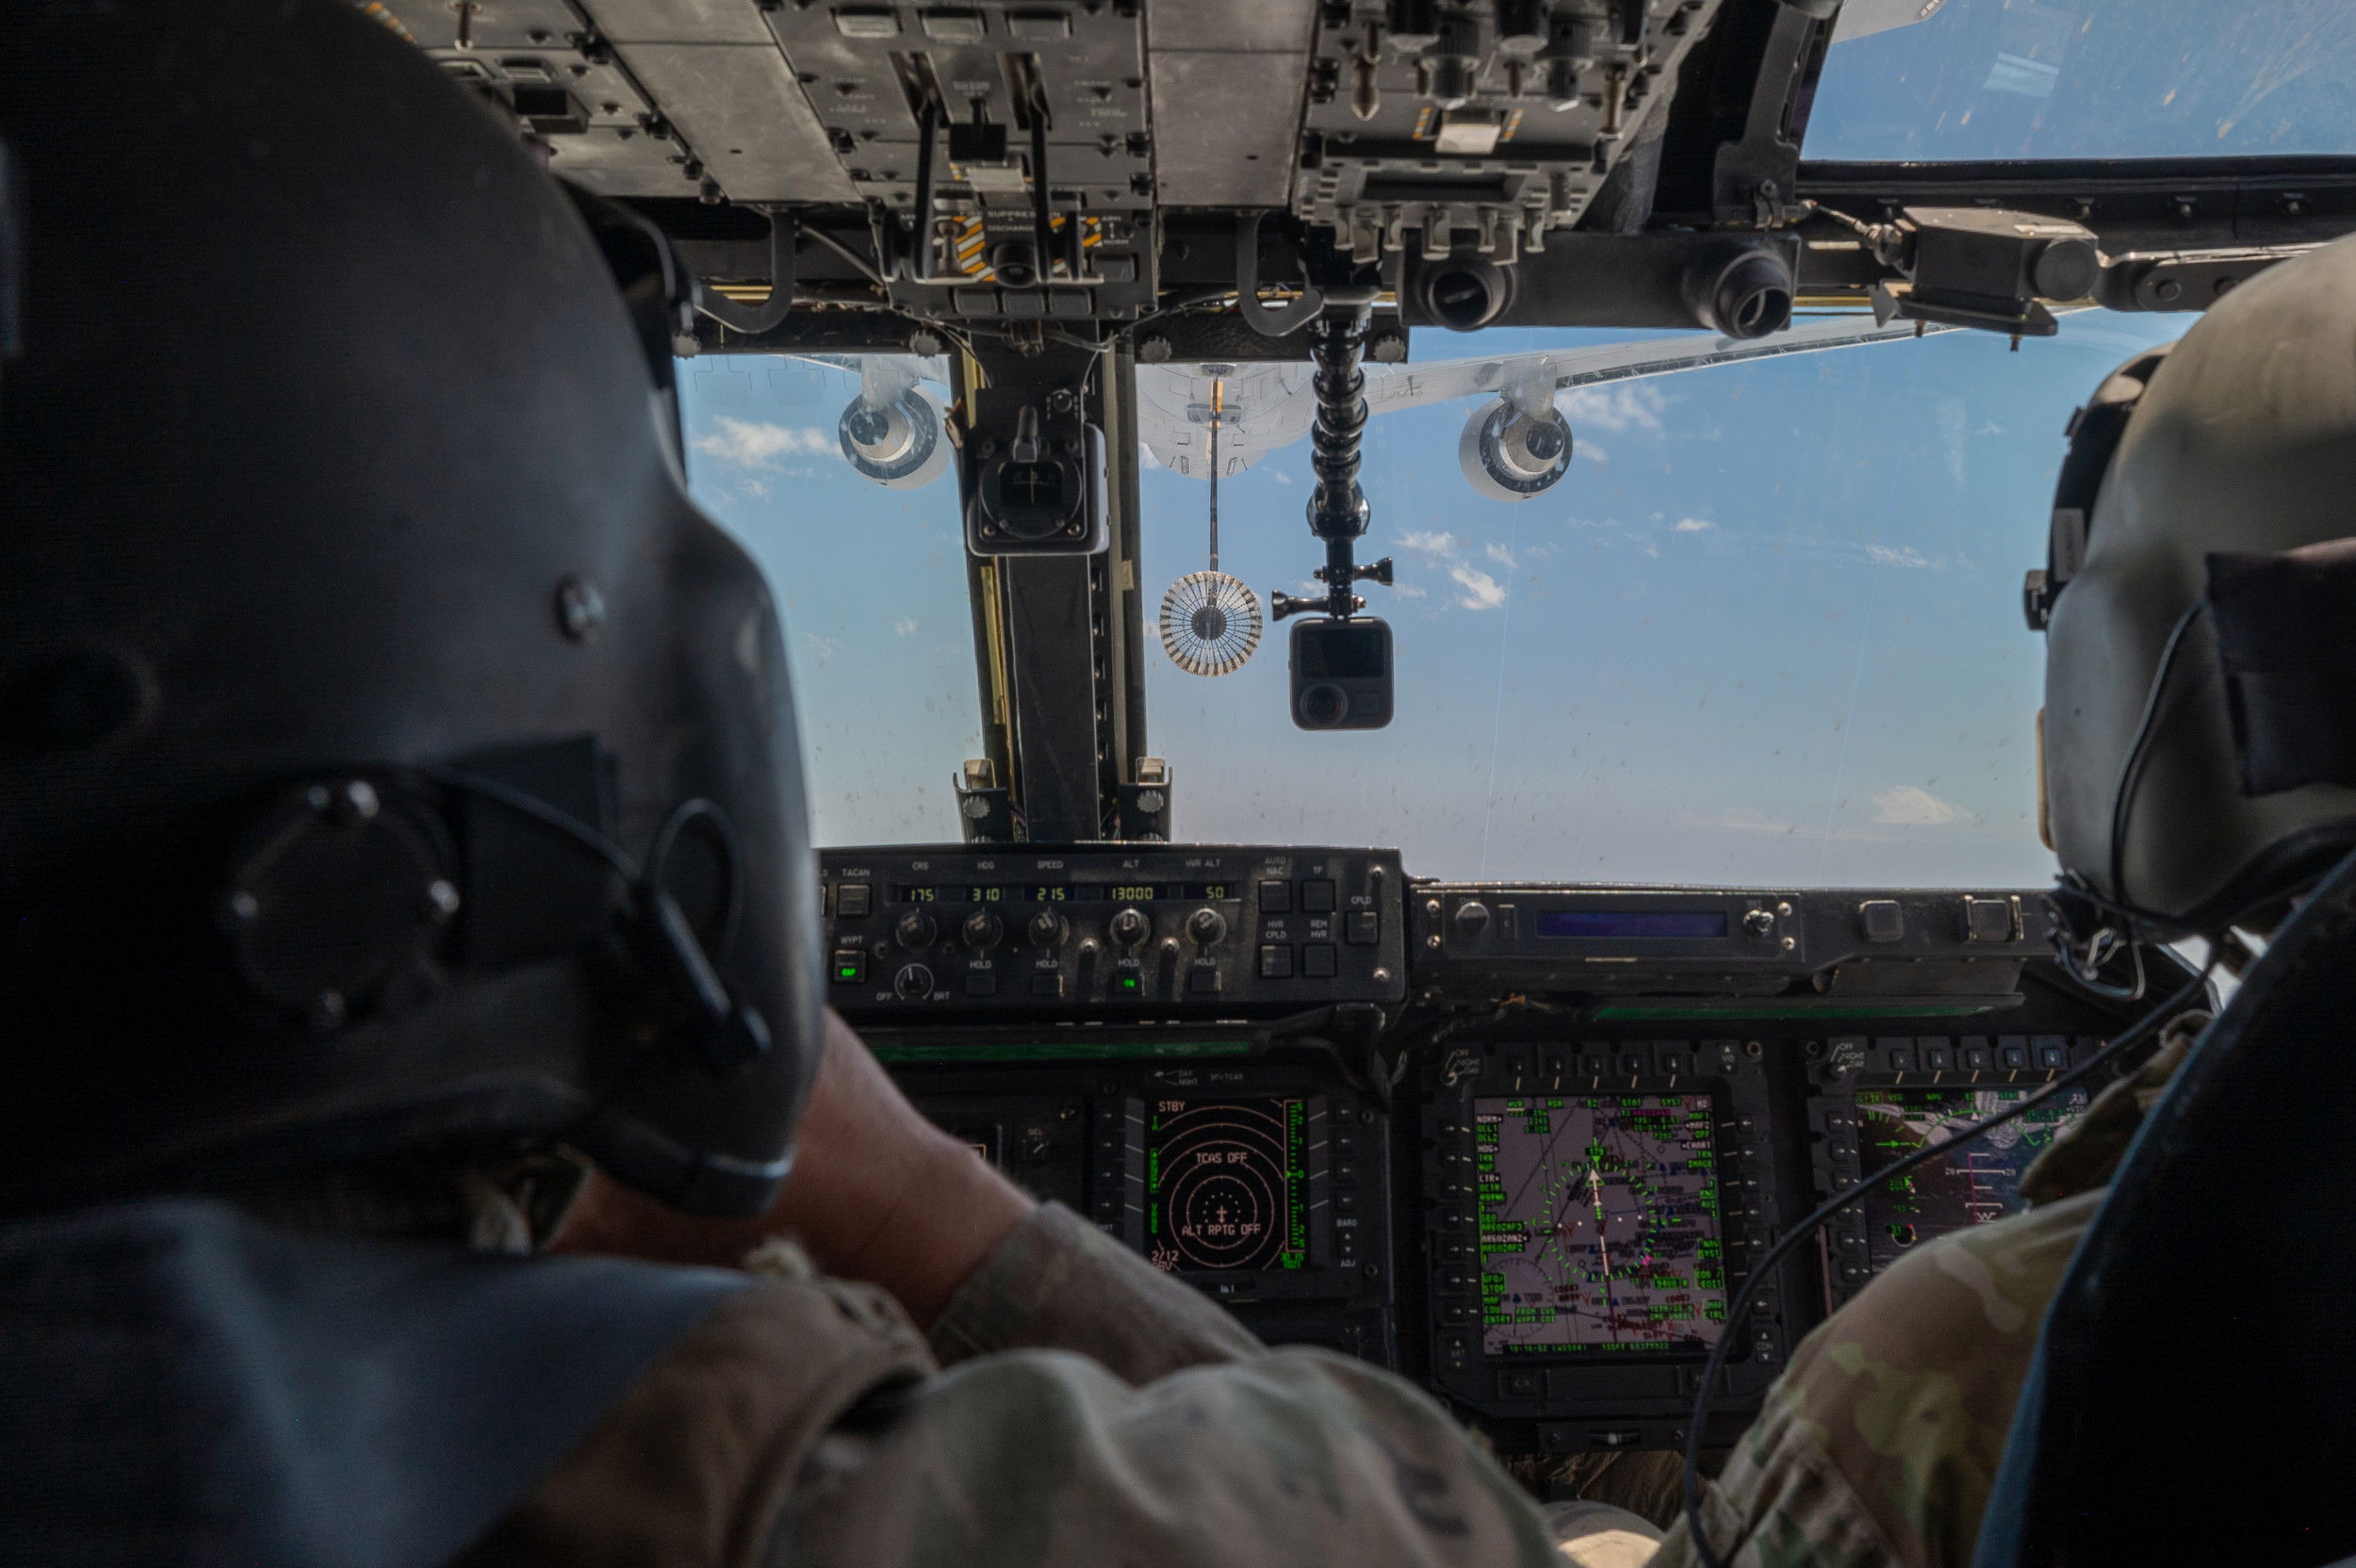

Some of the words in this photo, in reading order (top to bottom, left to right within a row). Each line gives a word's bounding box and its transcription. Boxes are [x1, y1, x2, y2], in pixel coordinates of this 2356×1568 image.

[911, 860, 929, 871] CRS
[977, 860, 995, 871] HDG
[1037, 859, 1064, 870] SPEED
[1122, 859, 1140, 868] ALT
[1204, 858, 1222, 868] ALT
[842, 868, 871, 877] TACAN
[910, 889, 935, 902] 175
[973, 888, 1001, 902] 310
[1036, 887, 1066, 902] 215
[1111, 887, 1154, 901] 13000
[1350, 896, 1372, 906] CPLD
[1265, 931, 1287, 940] CPLD
[969, 959, 992, 970] HOLD
[1035, 959, 1058, 969] HOLD
[1117, 957, 1141, 968] HOLD
[1193, 956, 1217, 967] HOLD
[875, 992, 893, 1002] OFF
[1839, 1042, 1854, 1052] OFF
[1158, 1101, 1186, 1112] STBY
[1196, 1152, 1222, 1164] TCAS
[1227, 1152, 1248, 1164] OFF
[1336, 1218, 1358, 1228] BARO
[1182, 1224, 1203, 1236] ALT
[1207, 1224, 1235, 1235] RPTG
[1240, 1223, 1262, 1234] OFF
[1340, 1259, 1357, 1267] ADJ
[1484, 1315, 1511, 1324] ENTRY
